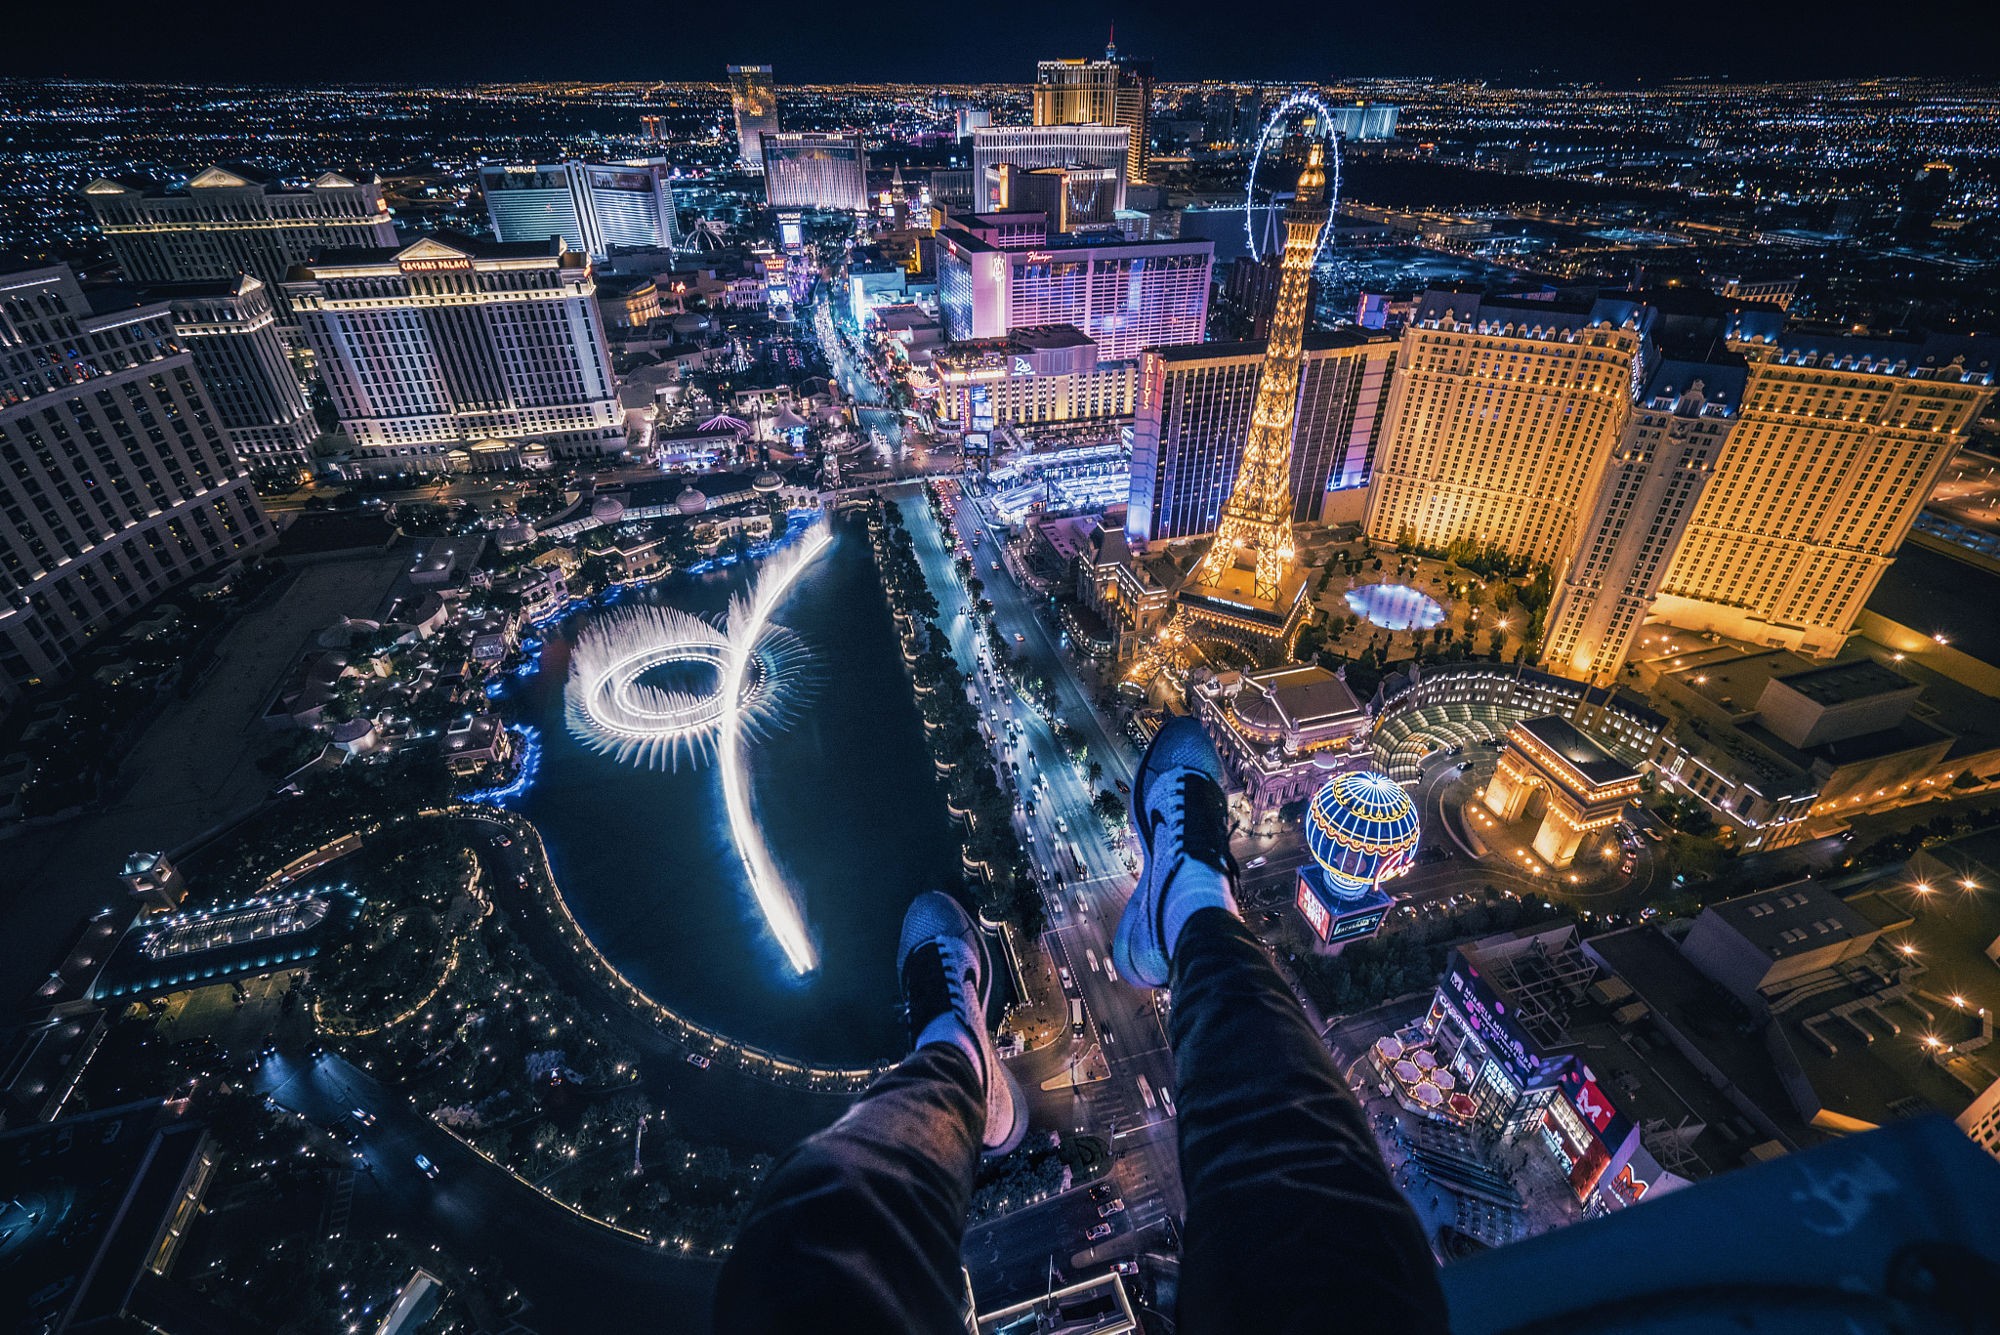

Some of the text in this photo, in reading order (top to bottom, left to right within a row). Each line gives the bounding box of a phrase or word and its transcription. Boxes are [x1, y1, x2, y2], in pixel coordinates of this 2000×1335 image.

[402, 260, 470, 270] CAESARS PALACE
[1465, 986, 1492, 1021] MIRACLE
[1493, 1020, 1508, 1041] MILE
[1509, 1040, 1532, 1070] SHOPS
